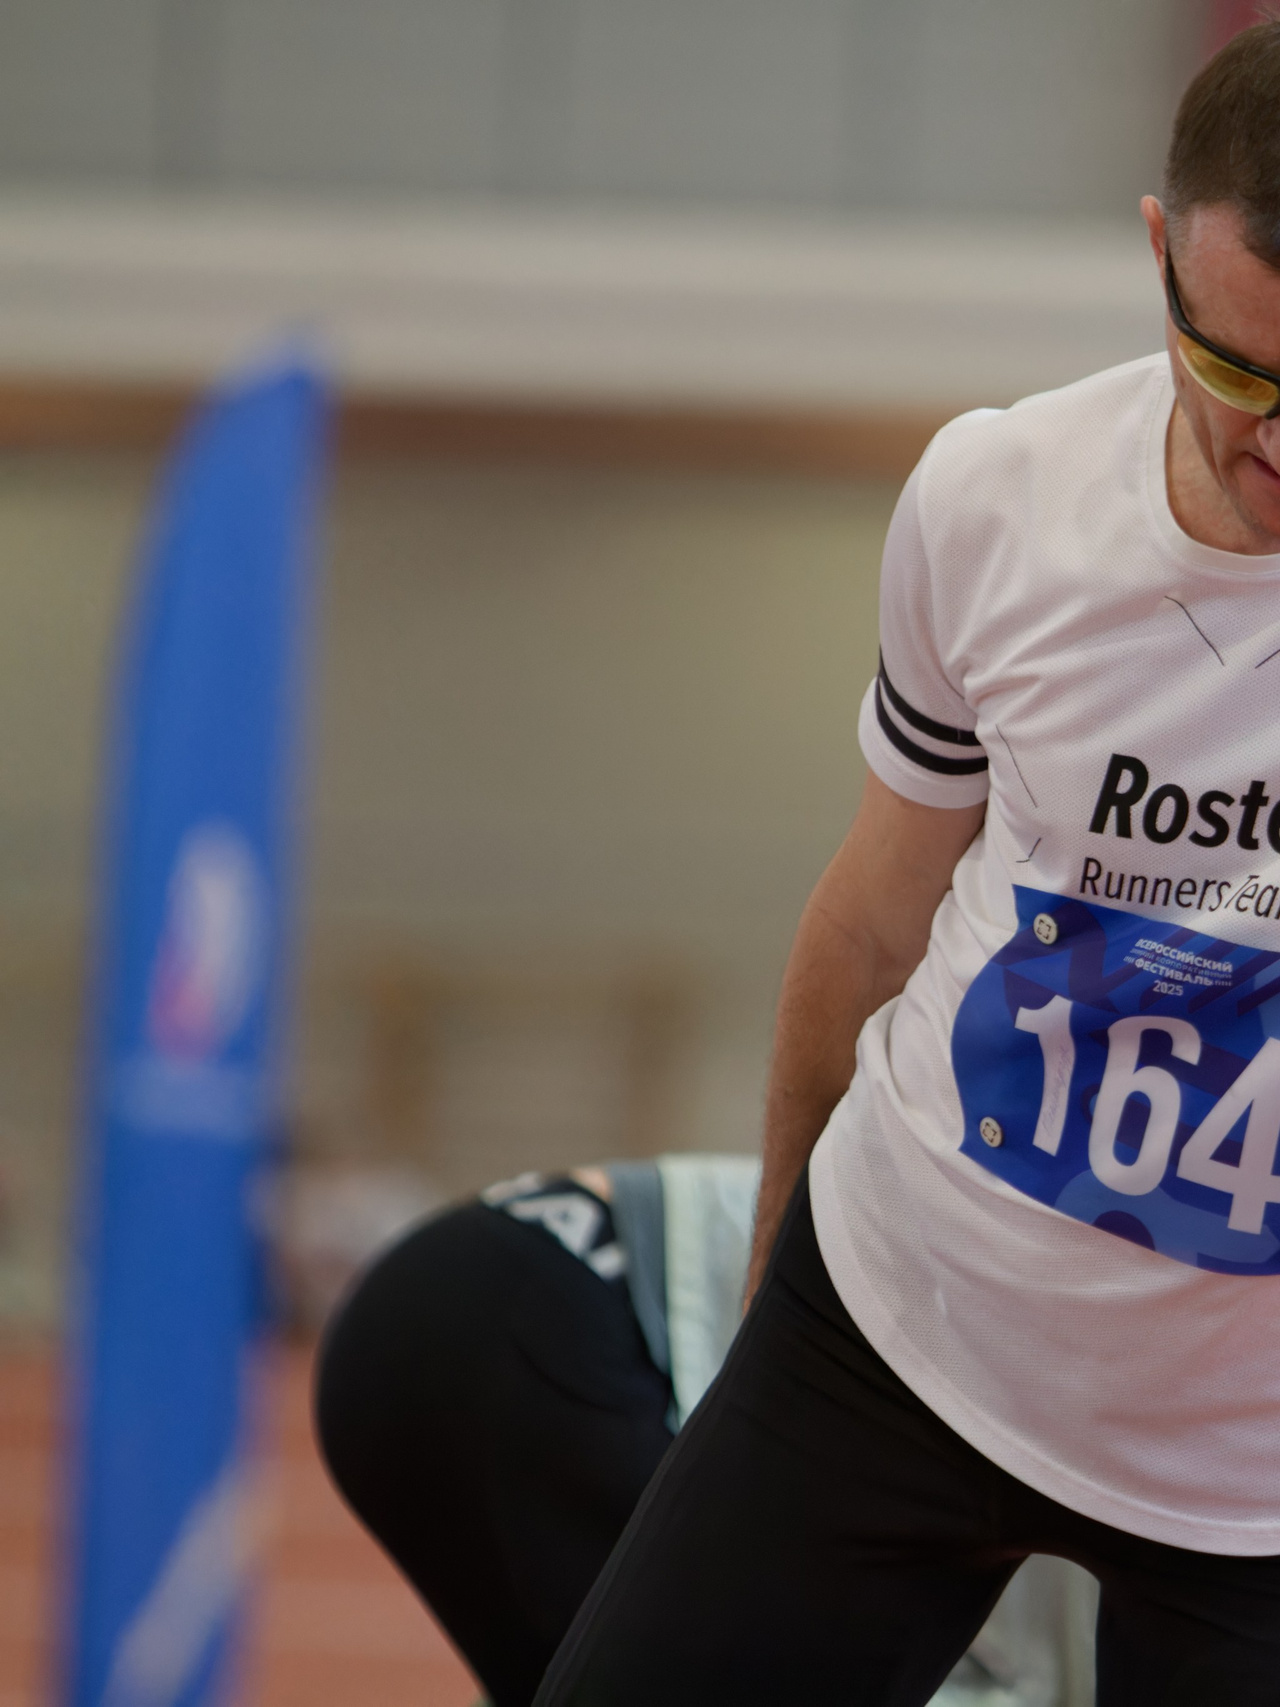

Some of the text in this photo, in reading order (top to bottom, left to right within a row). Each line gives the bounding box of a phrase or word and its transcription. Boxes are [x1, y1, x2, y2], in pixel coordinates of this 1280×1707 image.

[1079, 857, 1231, 912] Runners
[1135, 958, 1213, 986] ФЕСТИВАЛЬ
[1152, 980, 1184, 996] 2025
